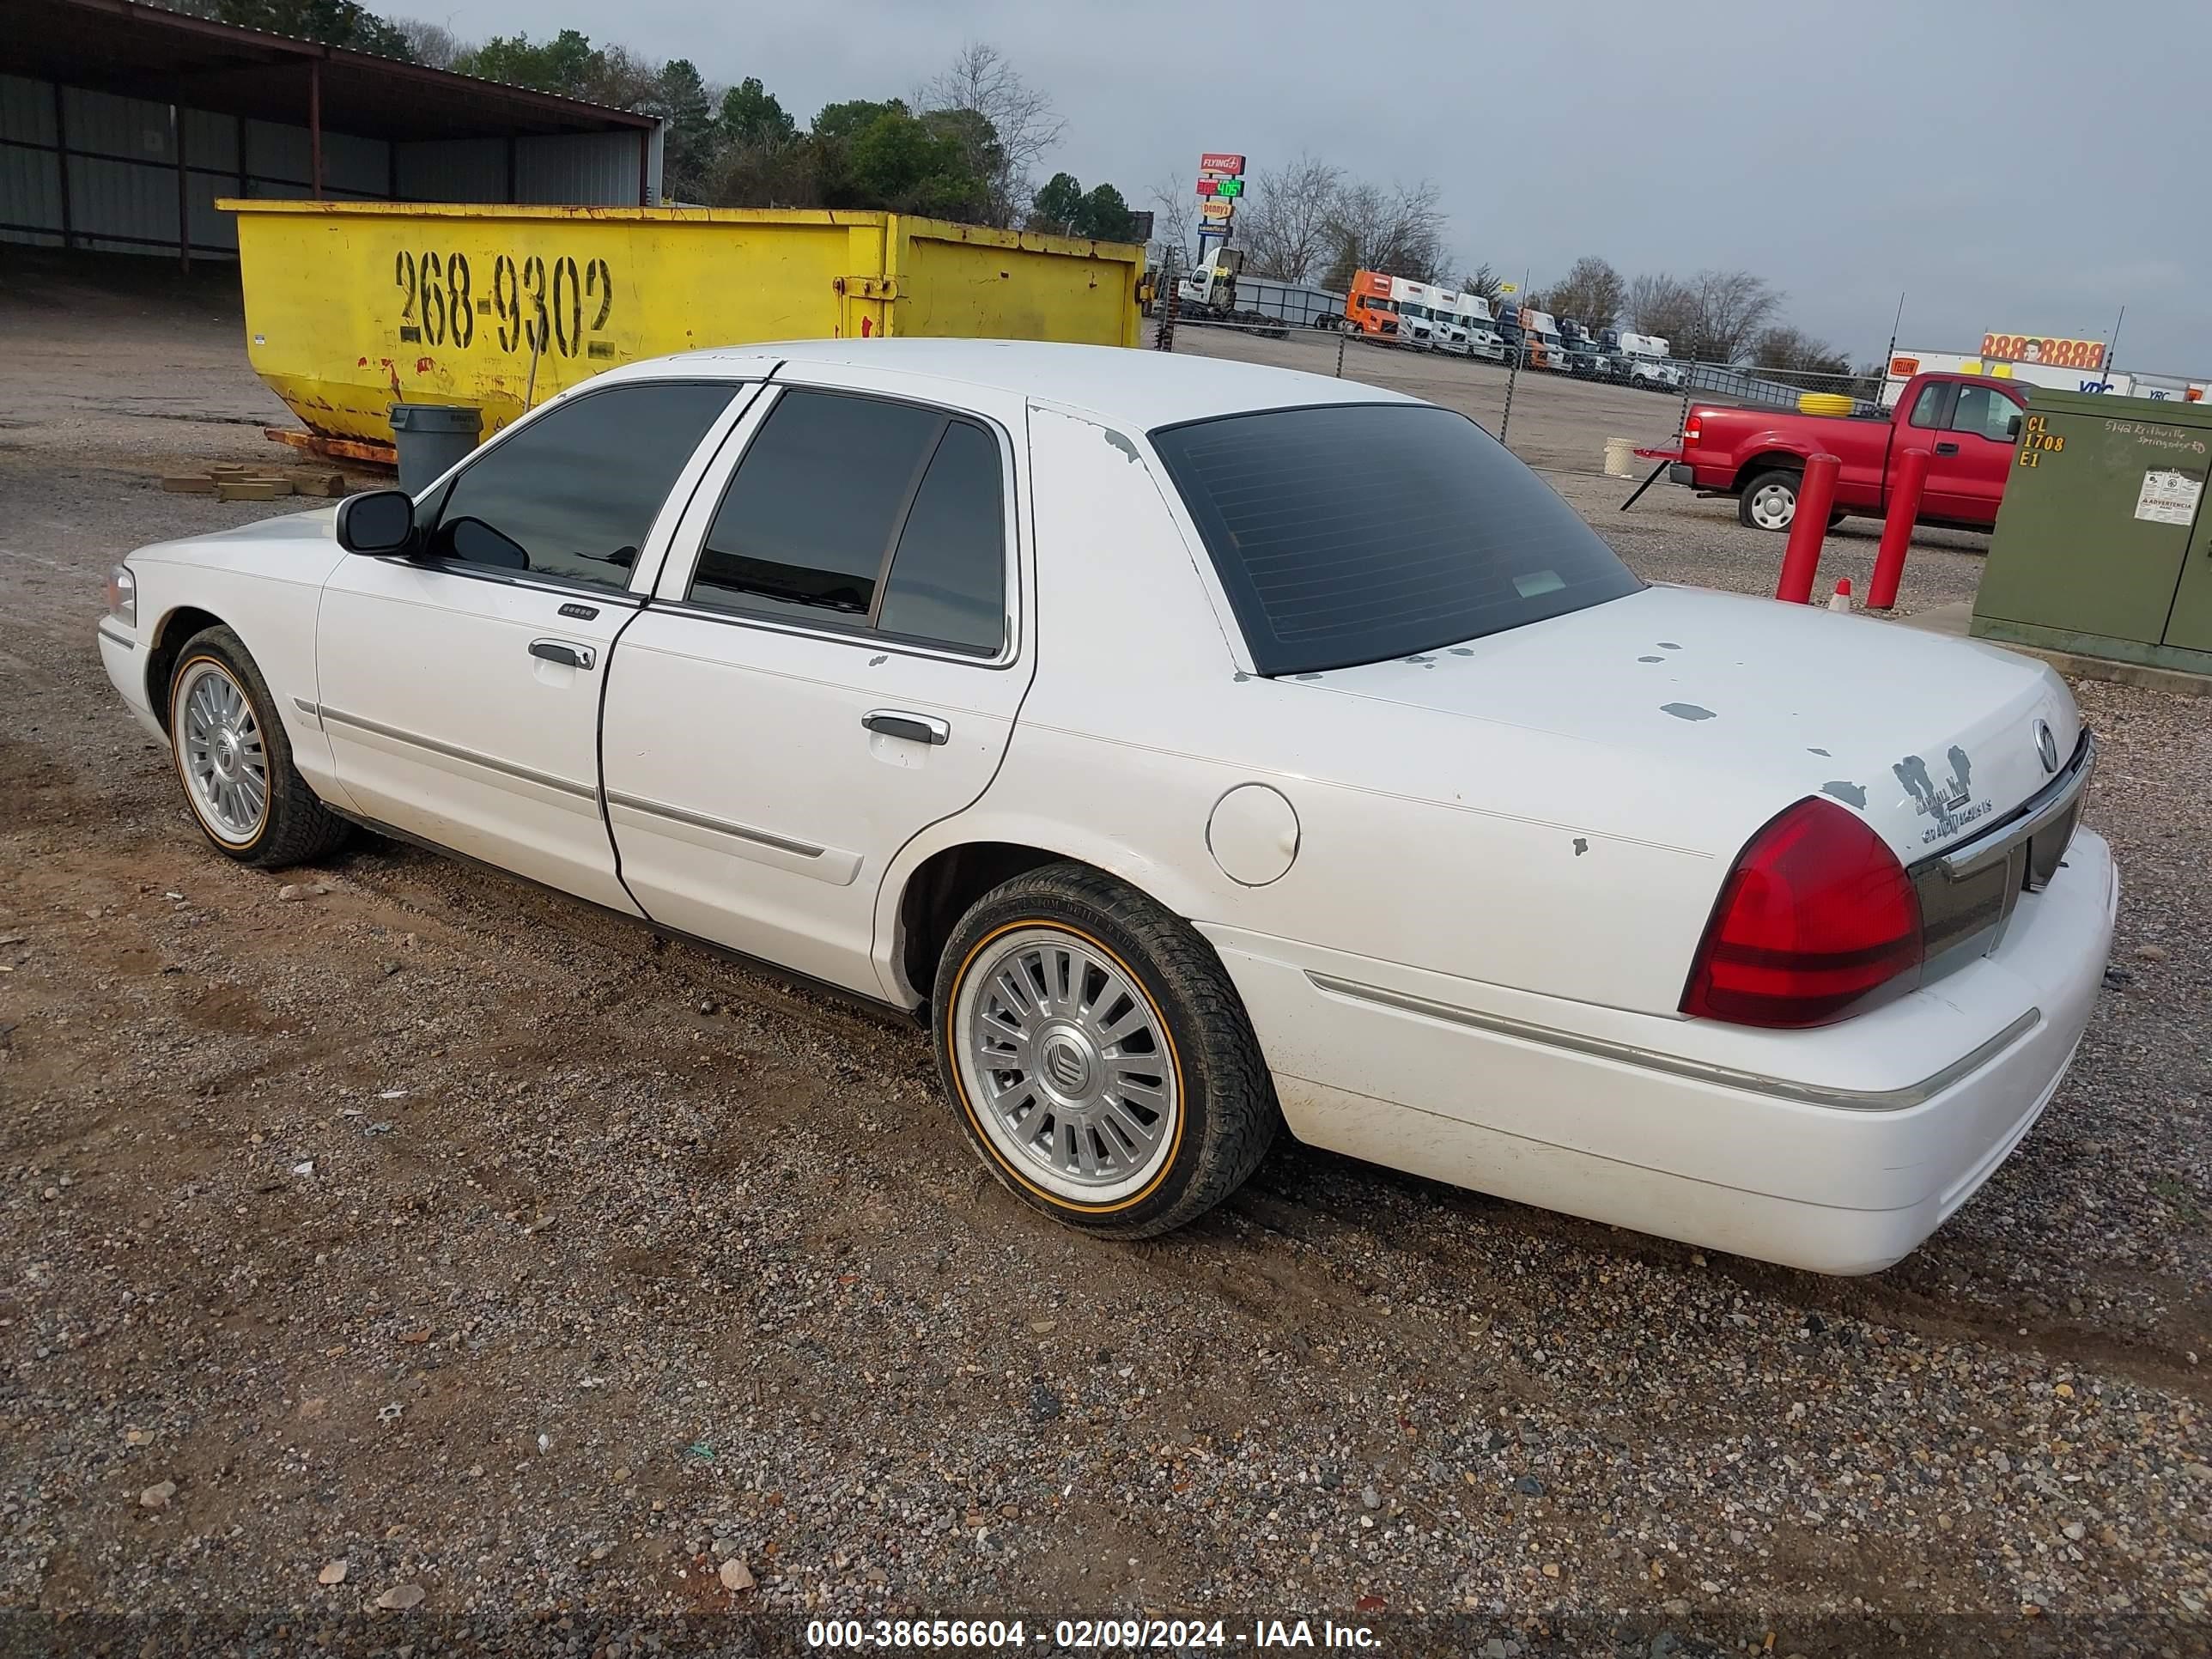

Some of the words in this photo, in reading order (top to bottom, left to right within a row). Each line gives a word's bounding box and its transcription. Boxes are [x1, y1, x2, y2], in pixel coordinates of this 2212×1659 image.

[1203, 158, 1229, 168] FLYING
[1204, 204, 1228, 215] Denny's
[396, 250, 616, 359] 268-9302
[2027, 416, 2046, 433] CL
[2023, 433, 2064, 452] 1708
[2019, 451, 2039, 468] E1
[2148, 499, 2192, 509] ADVERTENCIA
